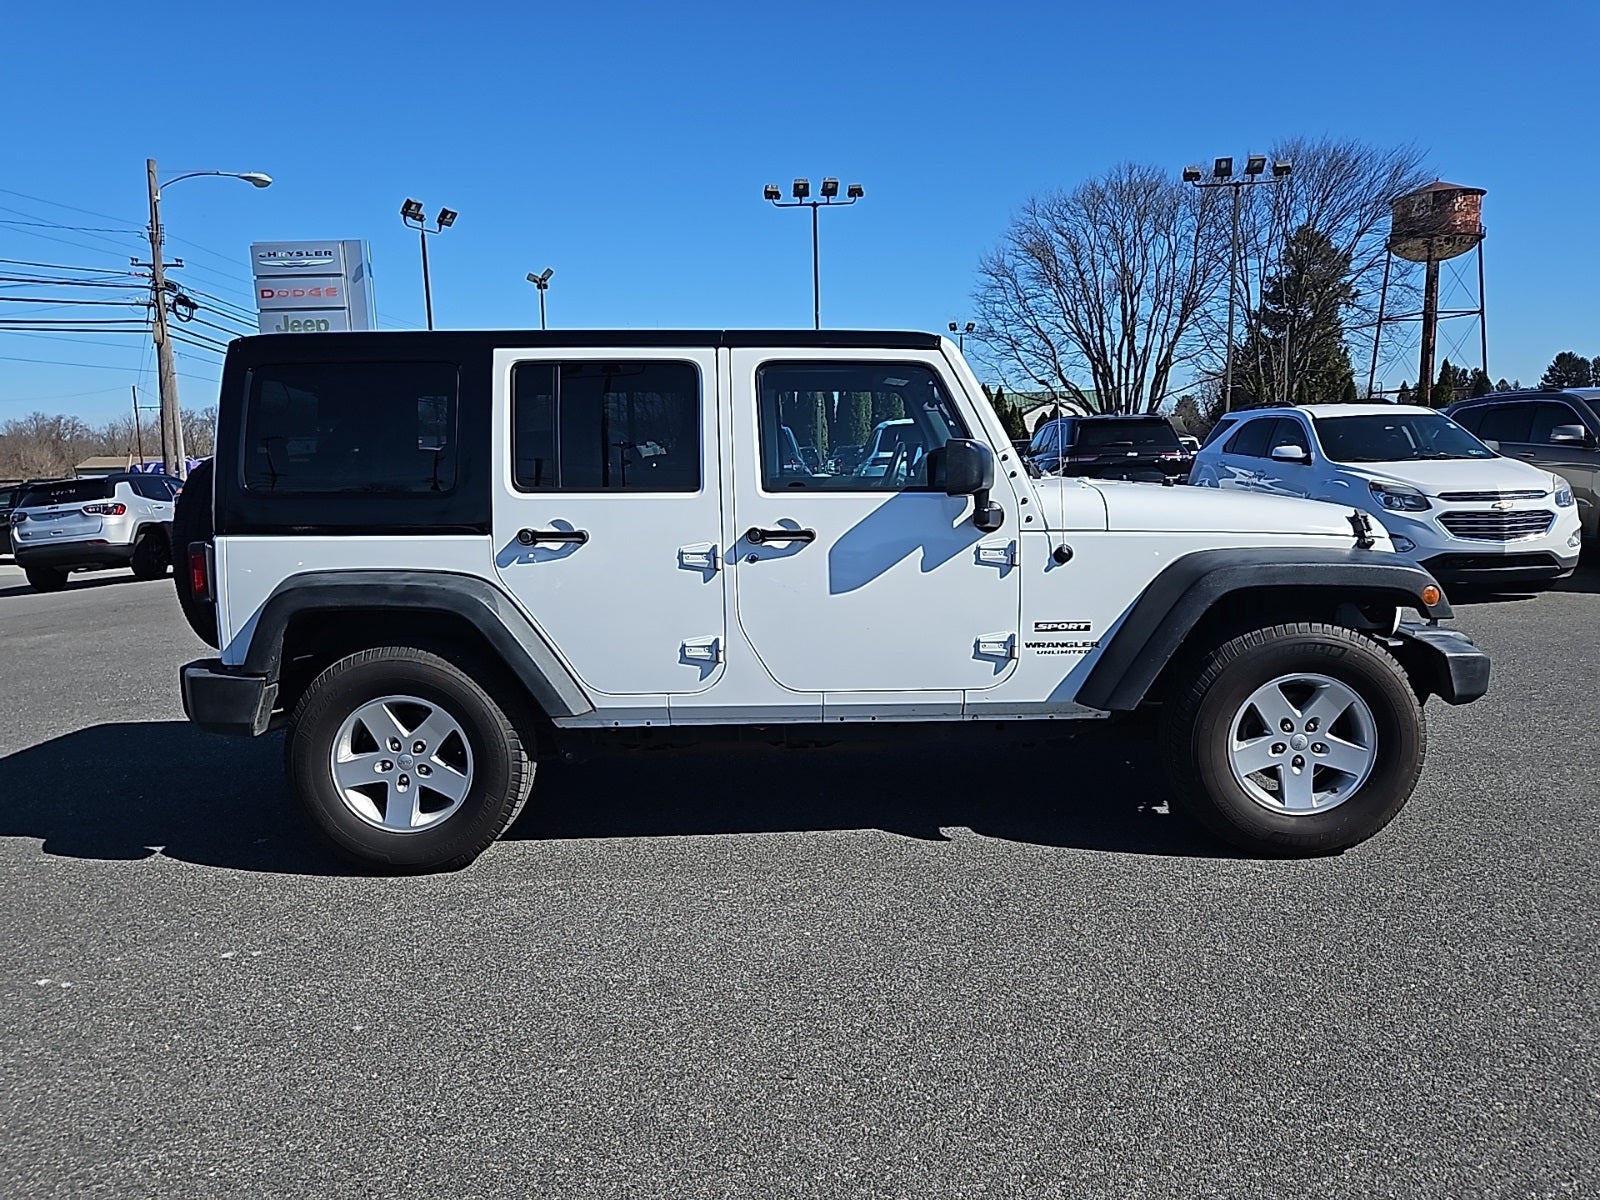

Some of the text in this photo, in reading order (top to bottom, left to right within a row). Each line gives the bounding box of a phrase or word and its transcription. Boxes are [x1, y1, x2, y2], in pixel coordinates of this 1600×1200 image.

[259, 250, 333, 258] CHRYSLER
[260, 287, 338, 299] DODGE
[275, 315, 330, 332] Jeep
